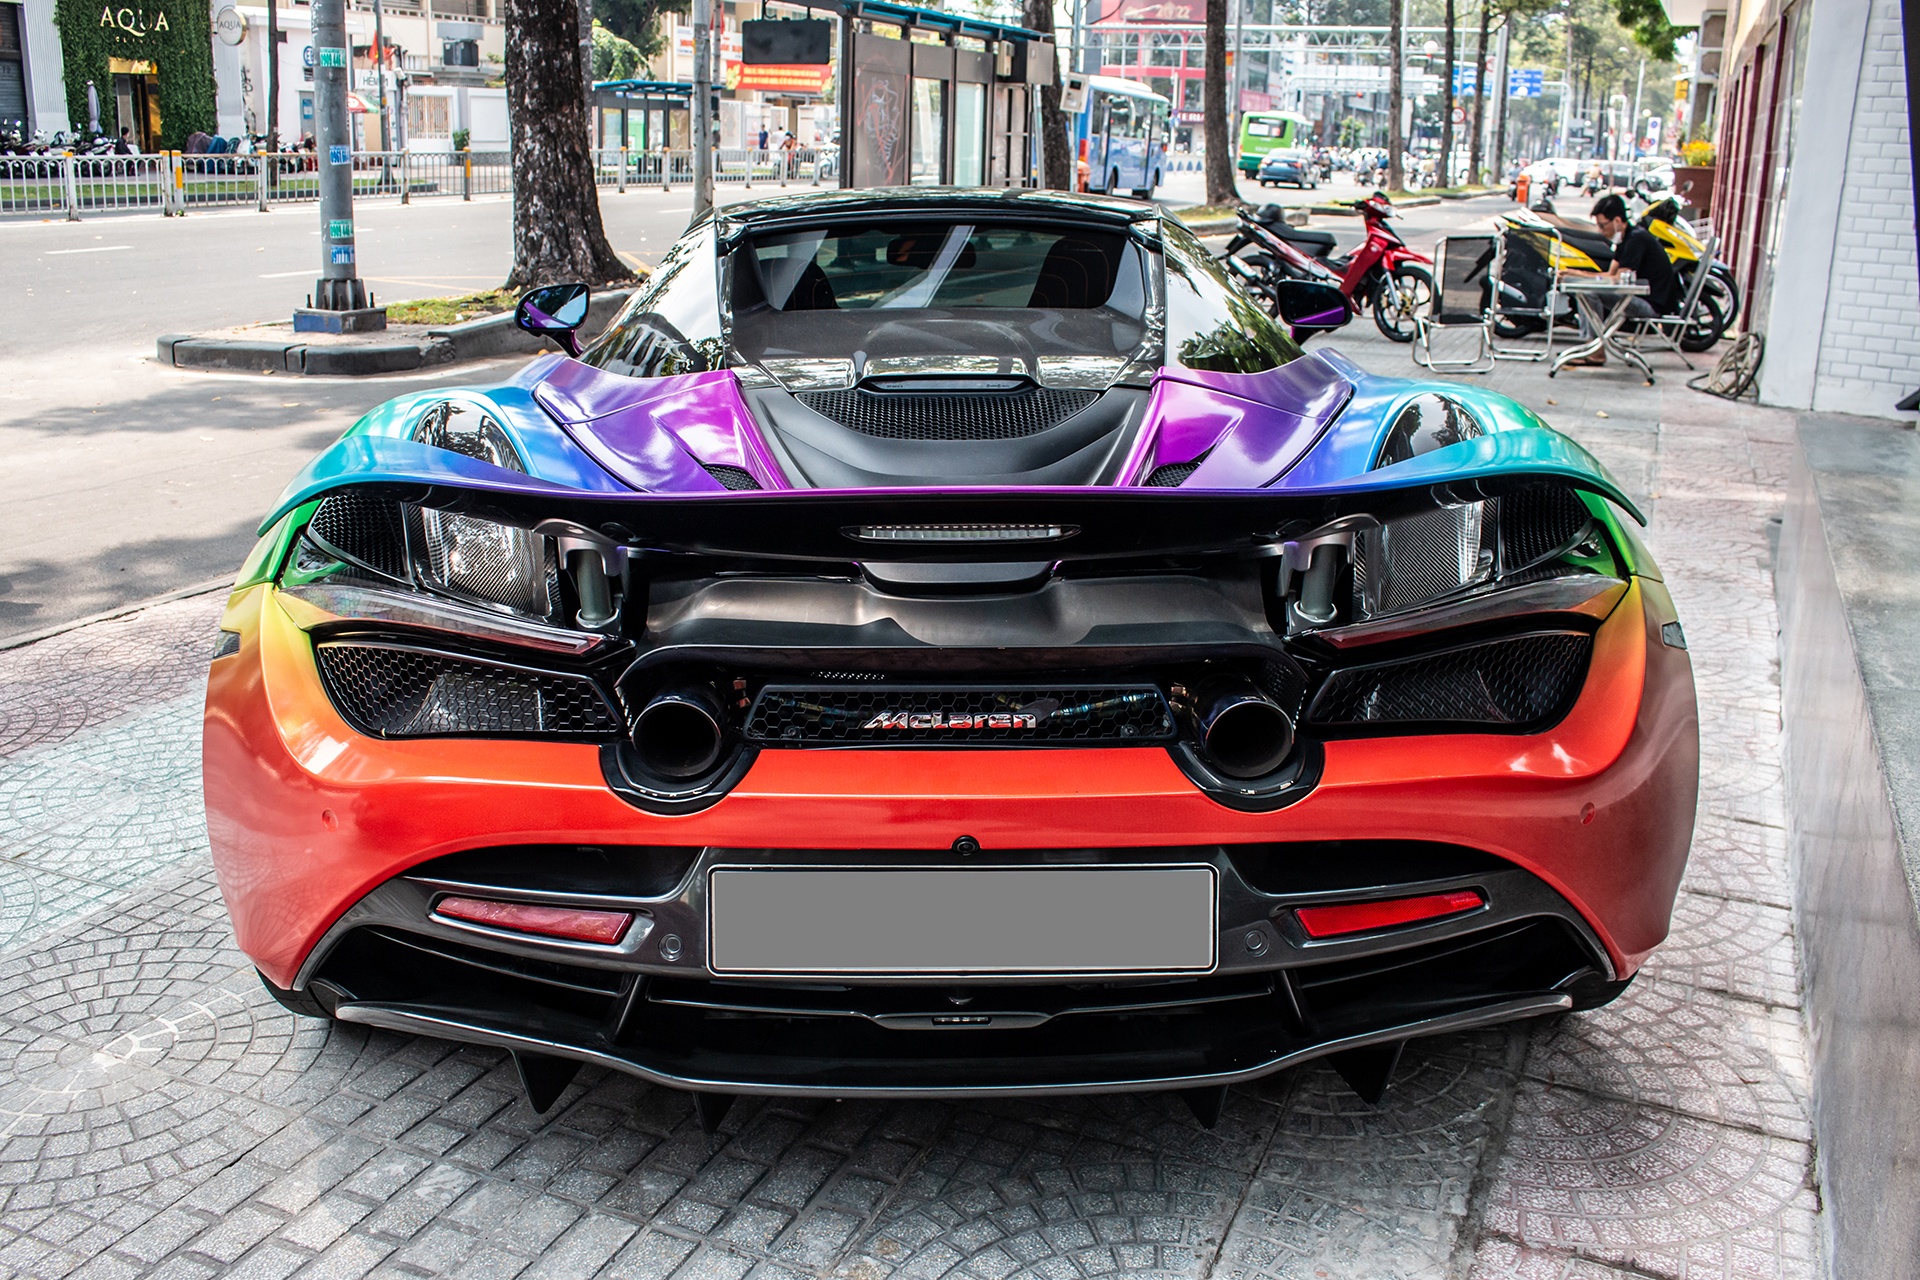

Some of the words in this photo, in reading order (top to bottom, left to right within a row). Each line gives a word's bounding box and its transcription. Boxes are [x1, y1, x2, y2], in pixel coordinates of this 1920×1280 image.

[100, 6, 170, 37] AQUA
[219, 20, 242, 31] AQUA
[863, 711, 1037, 729] McLaren
